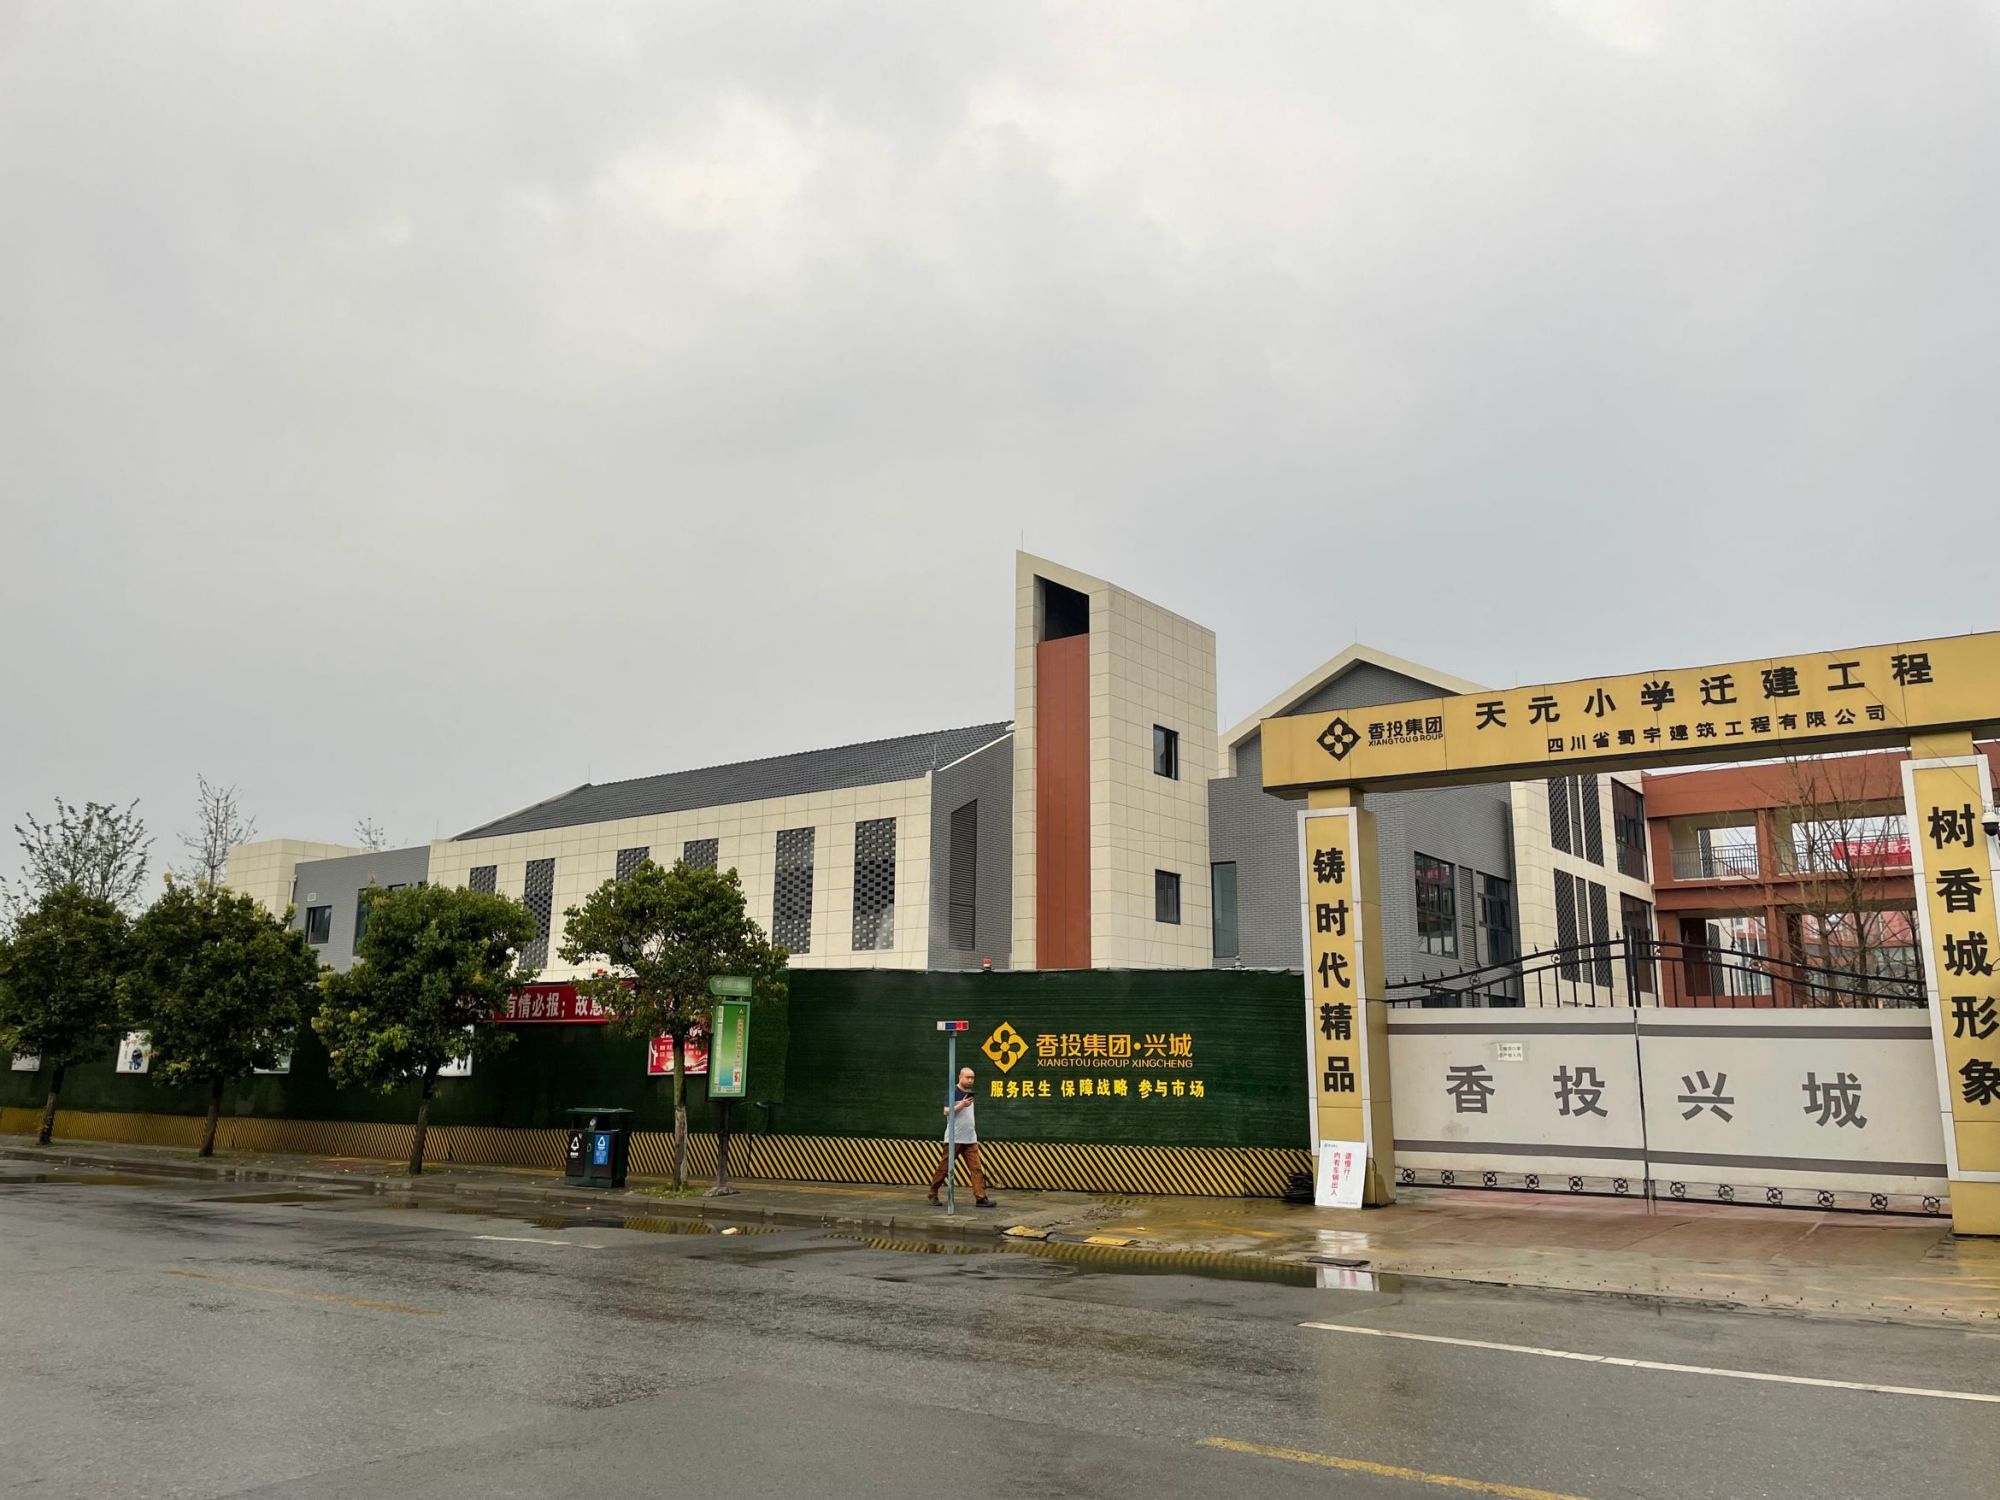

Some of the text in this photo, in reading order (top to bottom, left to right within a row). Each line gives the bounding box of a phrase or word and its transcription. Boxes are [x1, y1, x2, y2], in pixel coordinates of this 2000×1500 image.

[1475, 653, 1934, 730] 天元小学迁建工程
[1368, 716, 1443, 740] 香投集团
[1368, 733, 1444, 747] XIANGTOU GROUP
[1548, 704, 1886, 753] 四川省蜀宇建筑工程有限公司
[1313, 848, 1356, 1092] 铸时代精品
[1927, 803, 2000, 1106] 树香城形象
[1036, 1033, 1193, 1058] 香投集团·兴城
[1036, 1058, 1193, 1069] XIANGTOU GROUP XINGCHENG
[990, 1078, 1205, 1099] 服务民生 保障战略 参与市场
[1445, 1064, 1868, 1129] 香投兴城
